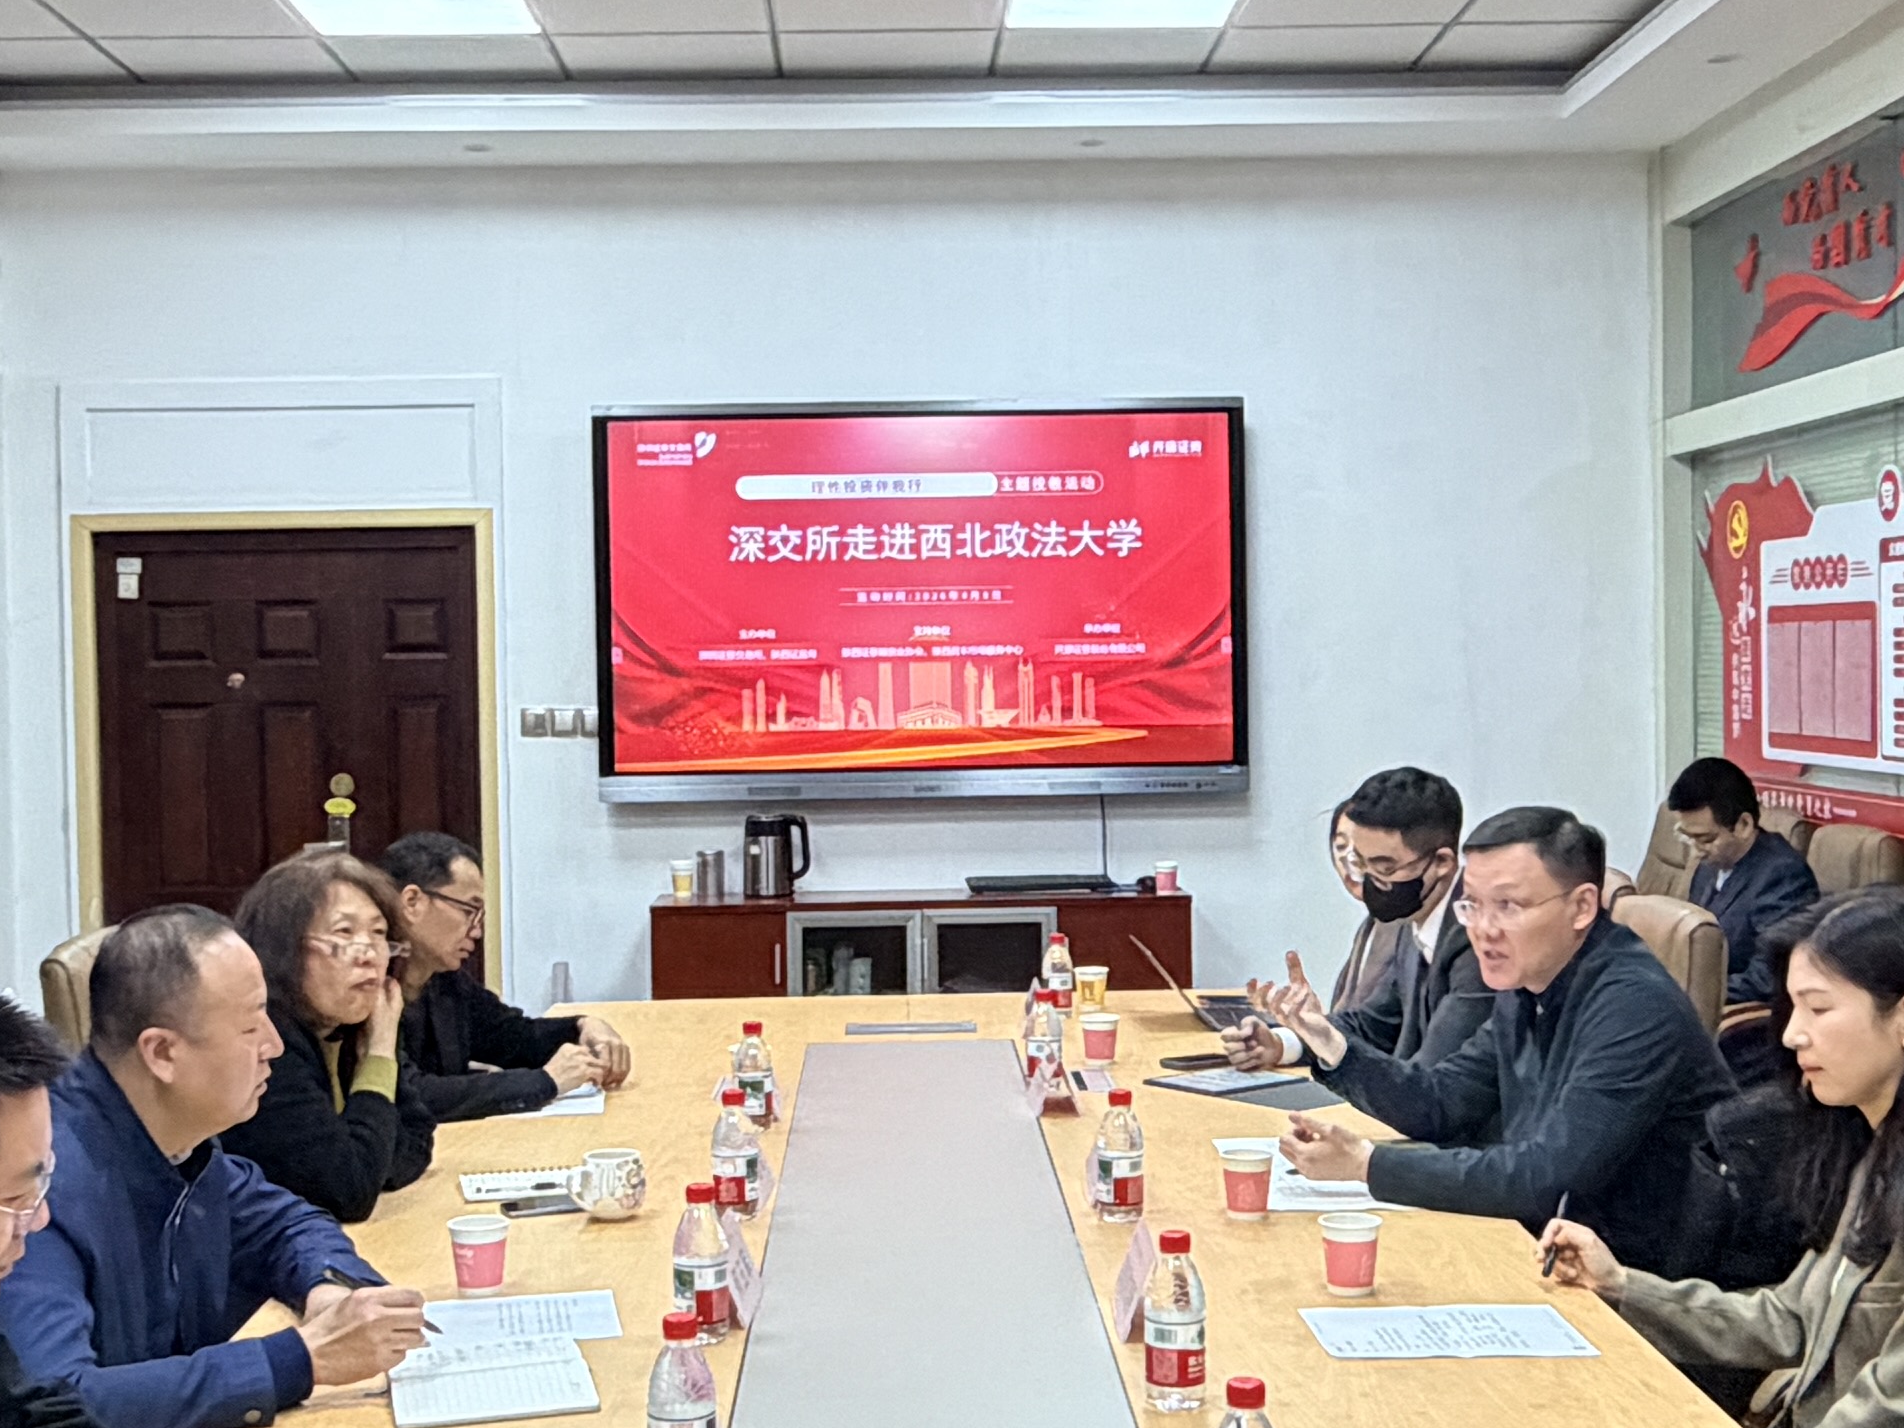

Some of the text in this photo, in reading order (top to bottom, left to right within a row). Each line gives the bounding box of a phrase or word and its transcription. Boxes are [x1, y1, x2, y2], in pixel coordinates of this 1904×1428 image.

[728, 518, 1143, 564] 深交所走进西北政法大学
